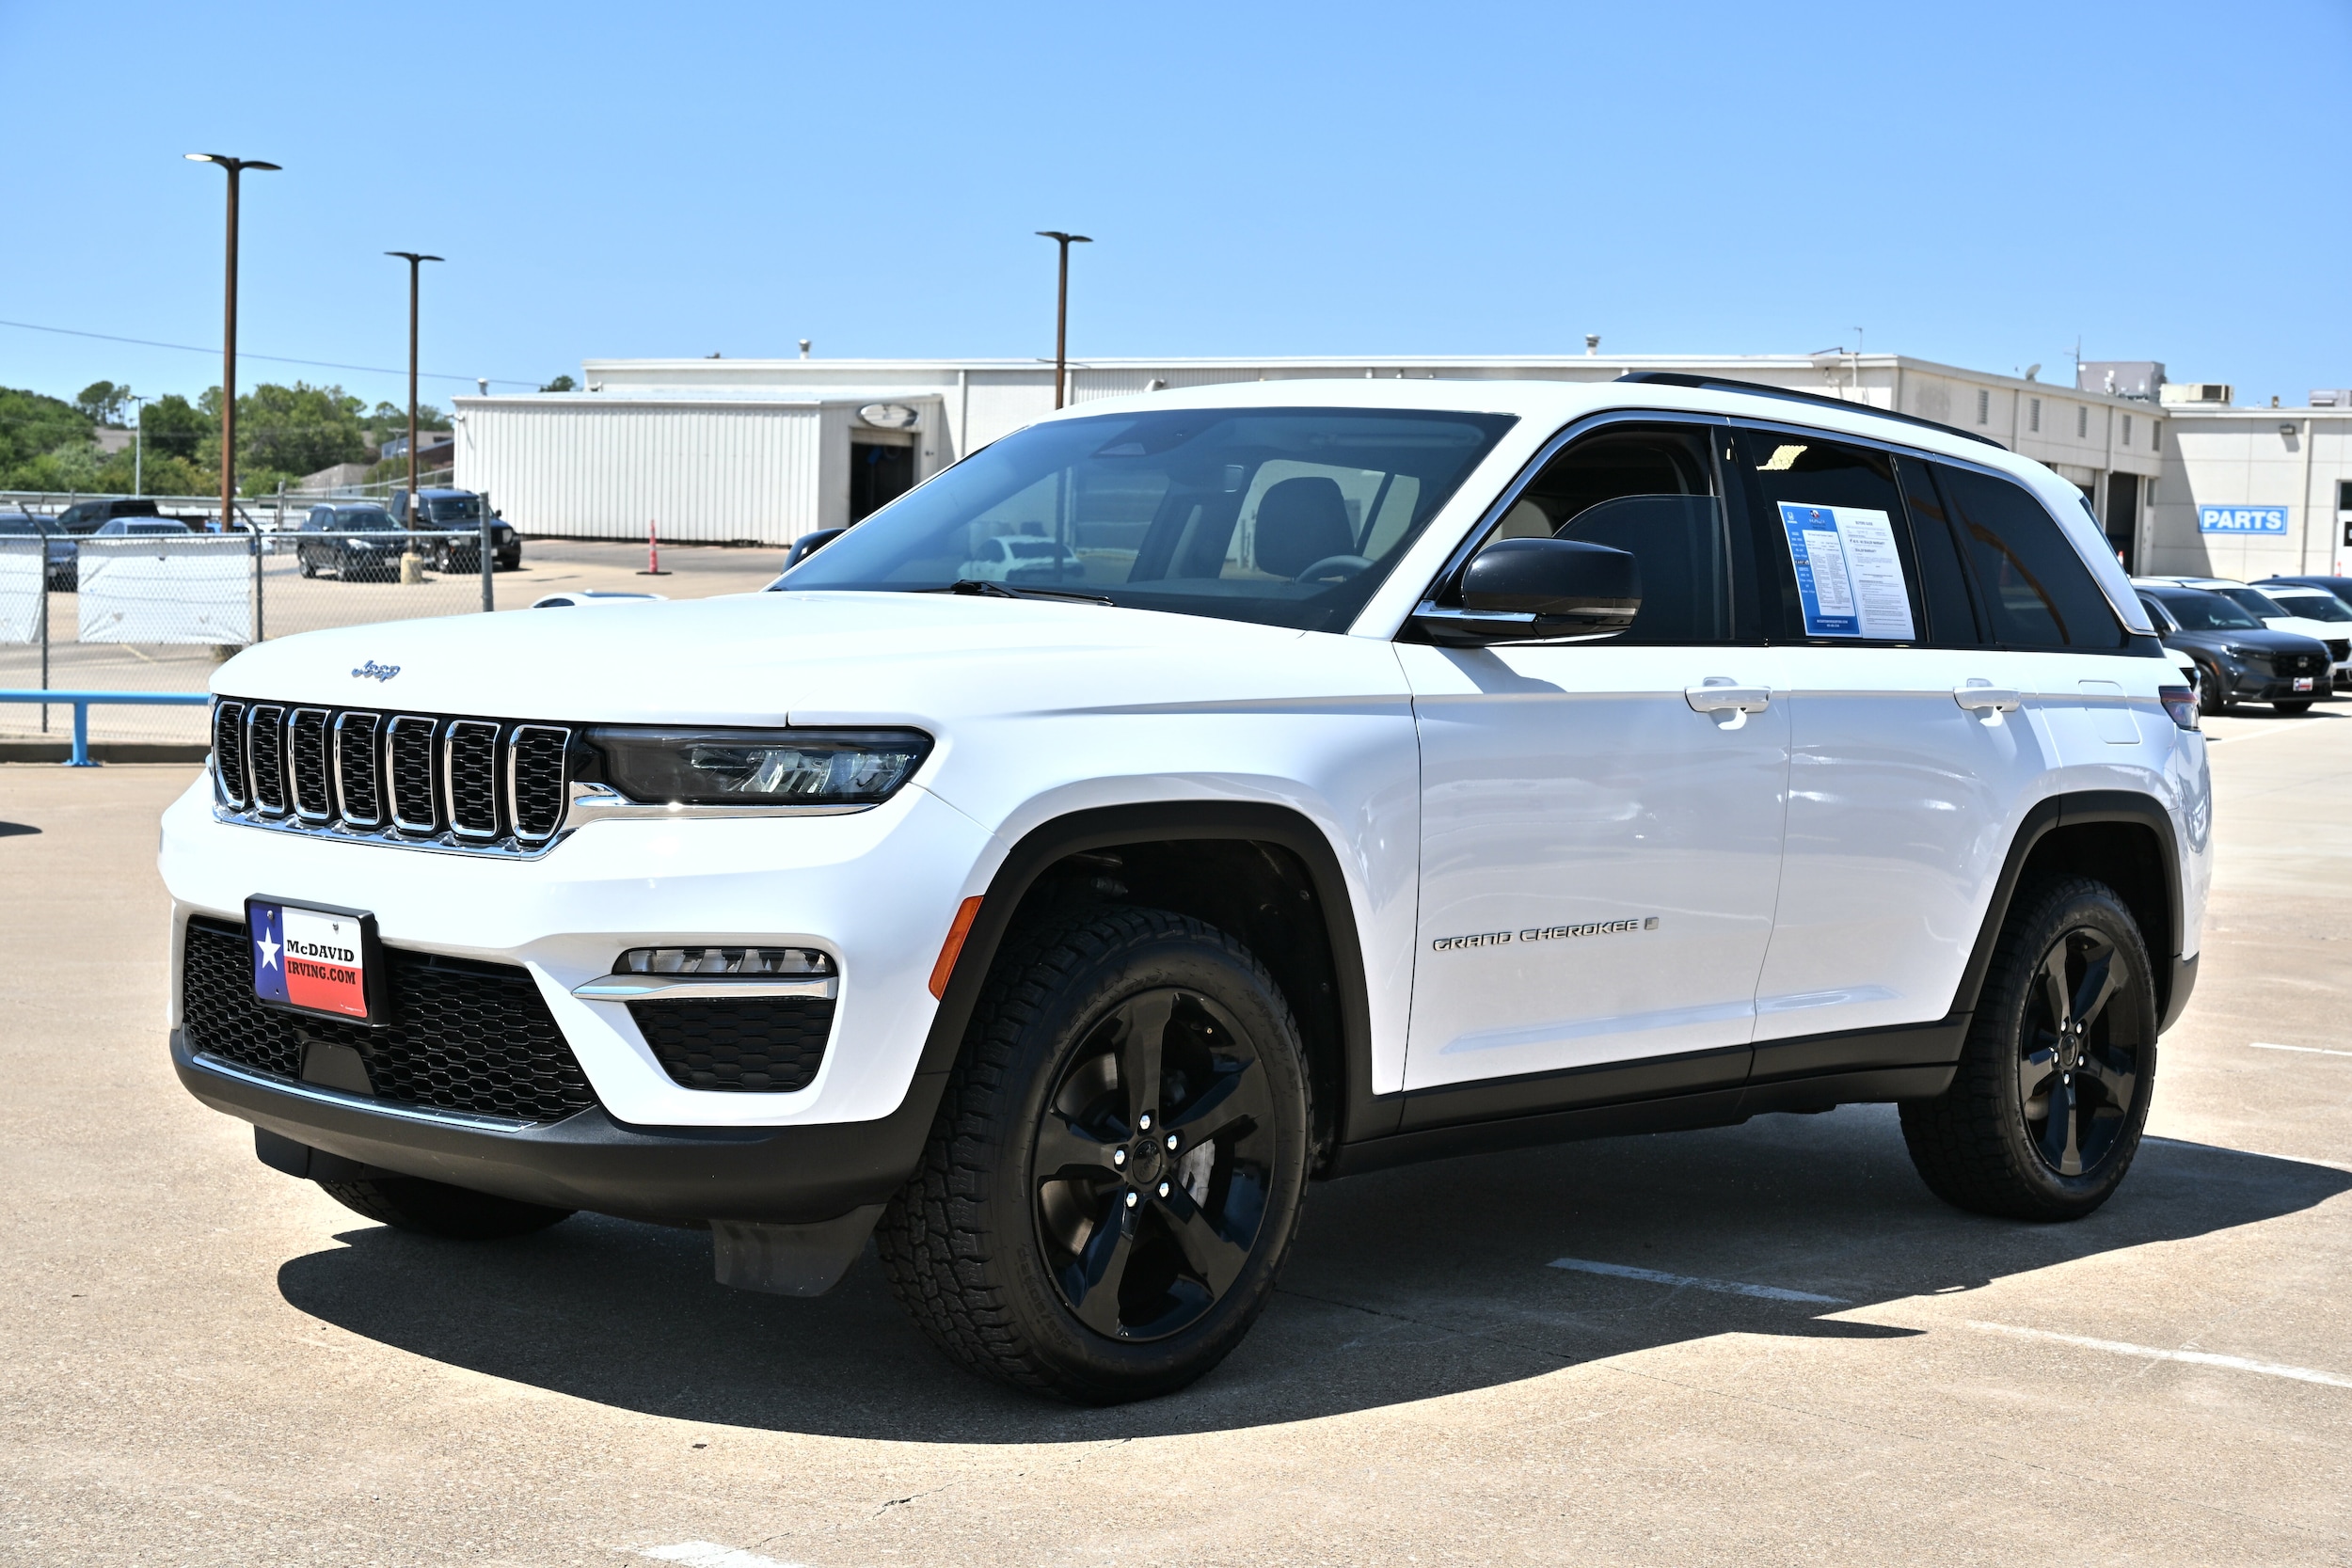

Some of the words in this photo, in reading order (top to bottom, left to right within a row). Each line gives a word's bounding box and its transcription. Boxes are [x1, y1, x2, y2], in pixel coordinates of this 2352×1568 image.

[2203, 510, 2282, 530] PARTS
[351, 659, 401, 684] Jeep
[1433, 930, 1514, 952] GRAND
[1520, 919, 1640, 942] CHEROKEE
[287, 940, 355, 962] McDAVID
[287, 960, 357, 985] IRVING.COM
